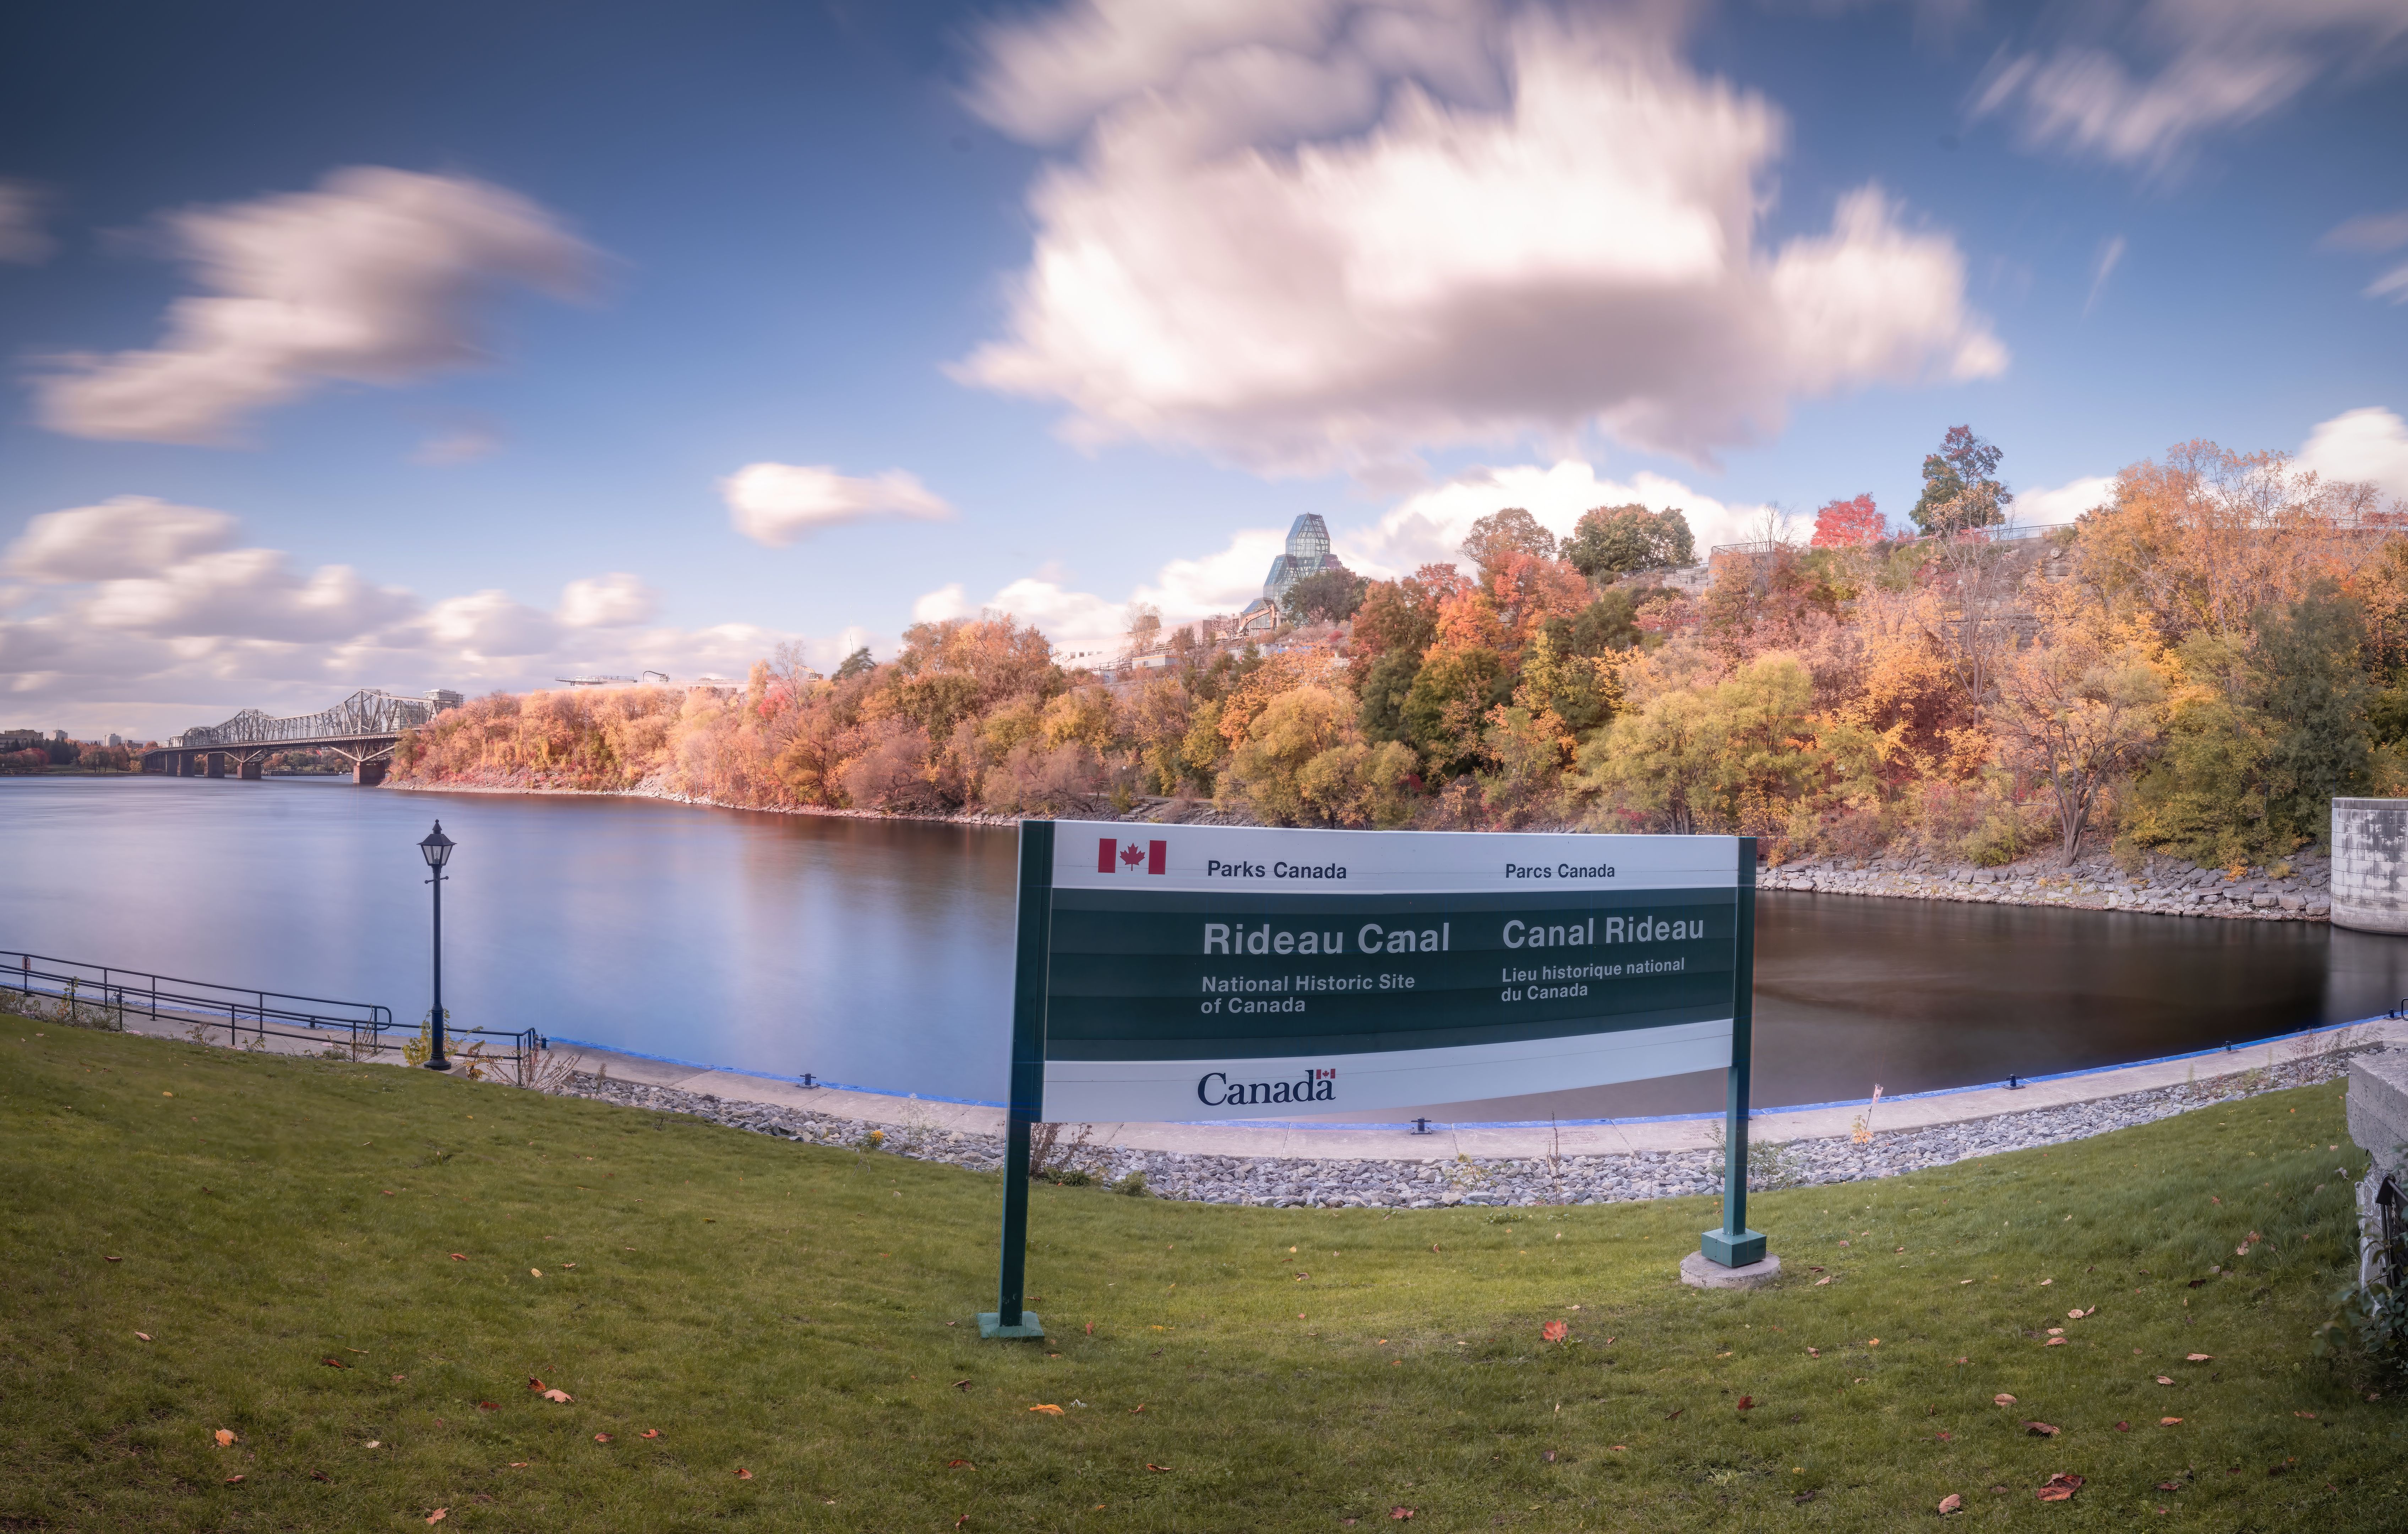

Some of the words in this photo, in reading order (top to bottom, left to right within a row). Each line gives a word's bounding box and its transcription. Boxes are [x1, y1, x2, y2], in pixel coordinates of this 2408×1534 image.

[1208, 860, 1265, 877] Parks
[1274, 862, 1346, 878] Canada
[1506, 864, 1551, 878] Parcs
[1558, 864, 1614, 878] Canada
[1204, 924, 1342, 954] Rideau
[1358, 923, 1449, 953] Canal
[1503, 918, 1593, 948] Canal
[1606, 916, 1703, 943] Rideau
[1503, 968, 1536, 982] Lieu
[1543, 963, 1621, 979] historique
[1627, 957, 1684, 974] national
[1203, 976, 1288, 992] National
[1296, 975, 1372, 990] Historic
[1379, 974, 1415, 989] Site
[1502, 988, 1521, 1001] du
[1527, 983, 1587, 1000] Canada
[1201, 998, 1221, 1013] of
[1228, 997, 1305, 1013] Canada
[1198, 1070, 1336, 1106] Canada
